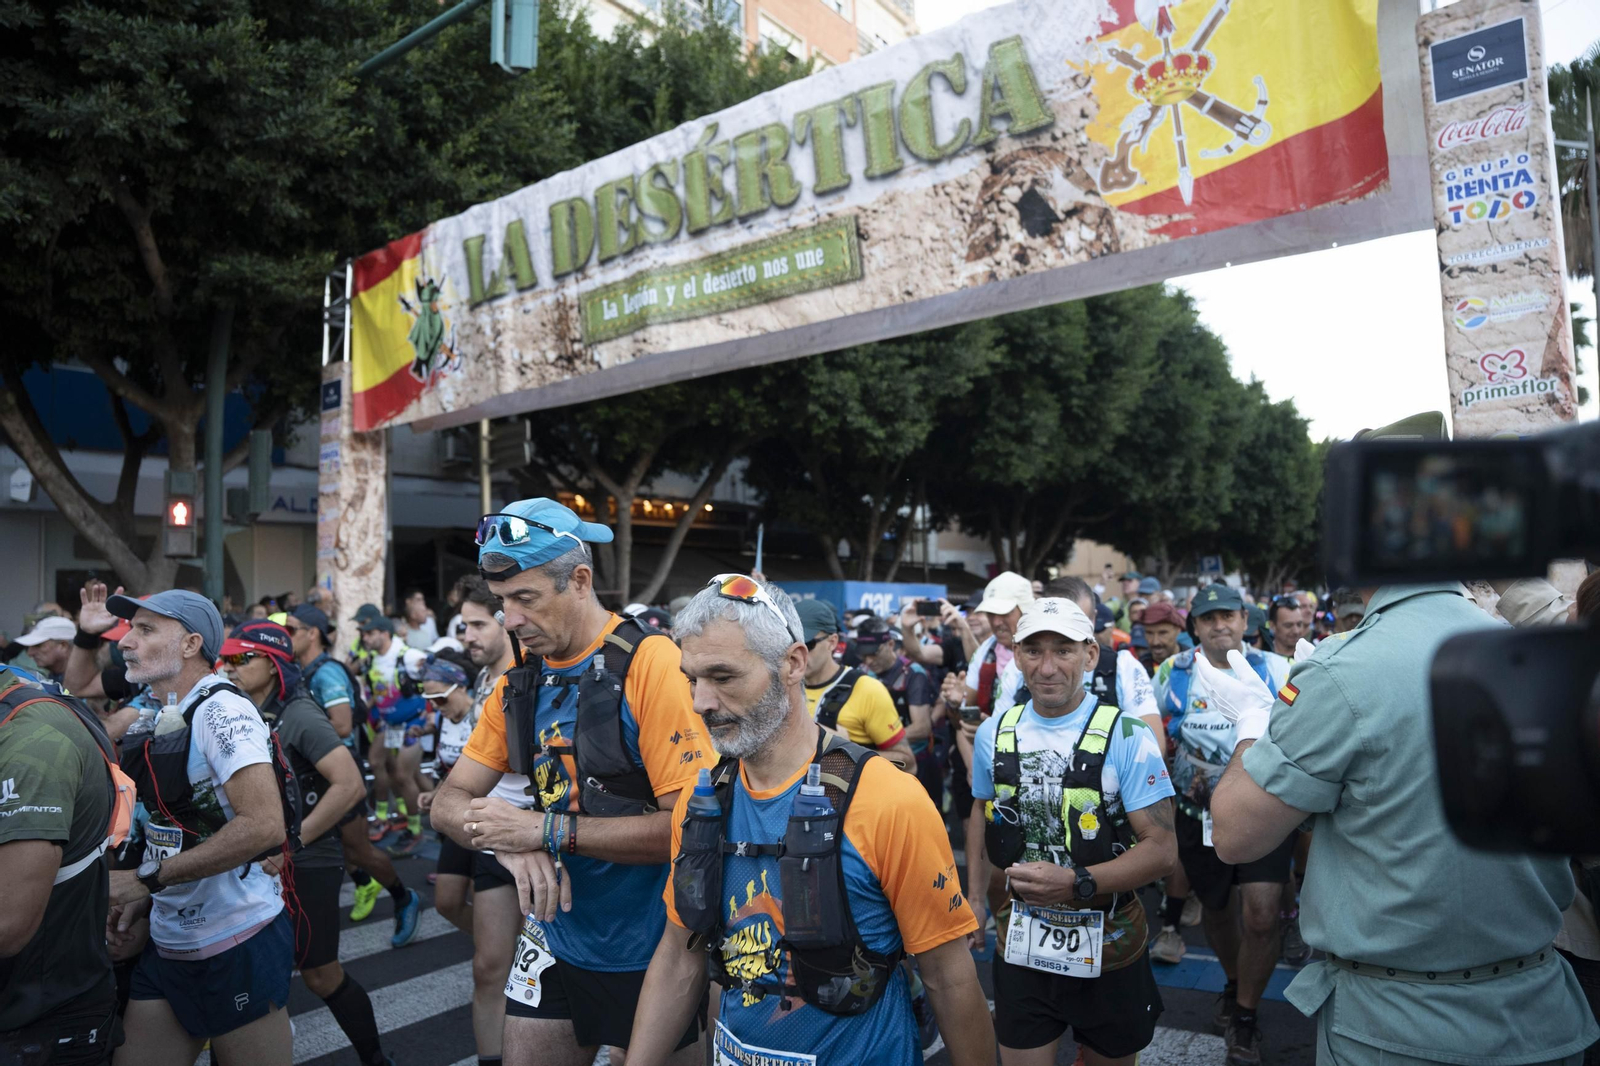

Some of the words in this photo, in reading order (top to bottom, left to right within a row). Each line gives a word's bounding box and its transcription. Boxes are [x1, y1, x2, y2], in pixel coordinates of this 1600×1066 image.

[1452, 57, 1504, 79] SENATOR
[1438, 105, 1528, 148] Coca-Cola
[463, 218, 535, 309] LA
[549, 34, 1055, 278] DESÉRTICA
[1446, 154, 1529, 181] GRUPO
[1447, 169, 1534, 202] RENTA
[1448, 190, 1535, 224] TODO
[602, 299, 619, 320] La
[665, 285, 676, 307] y
[683, 276, 697, 299] el
[703, 264, 757, 295] desierto
[763, 256, 789, 279] nos
[794, 247, 824, 270] une
[1463, 378, 1557, 407] primaflor
[1038, 923, 1080, 953] 790
[1034, 958, 1062, 971] asisa
